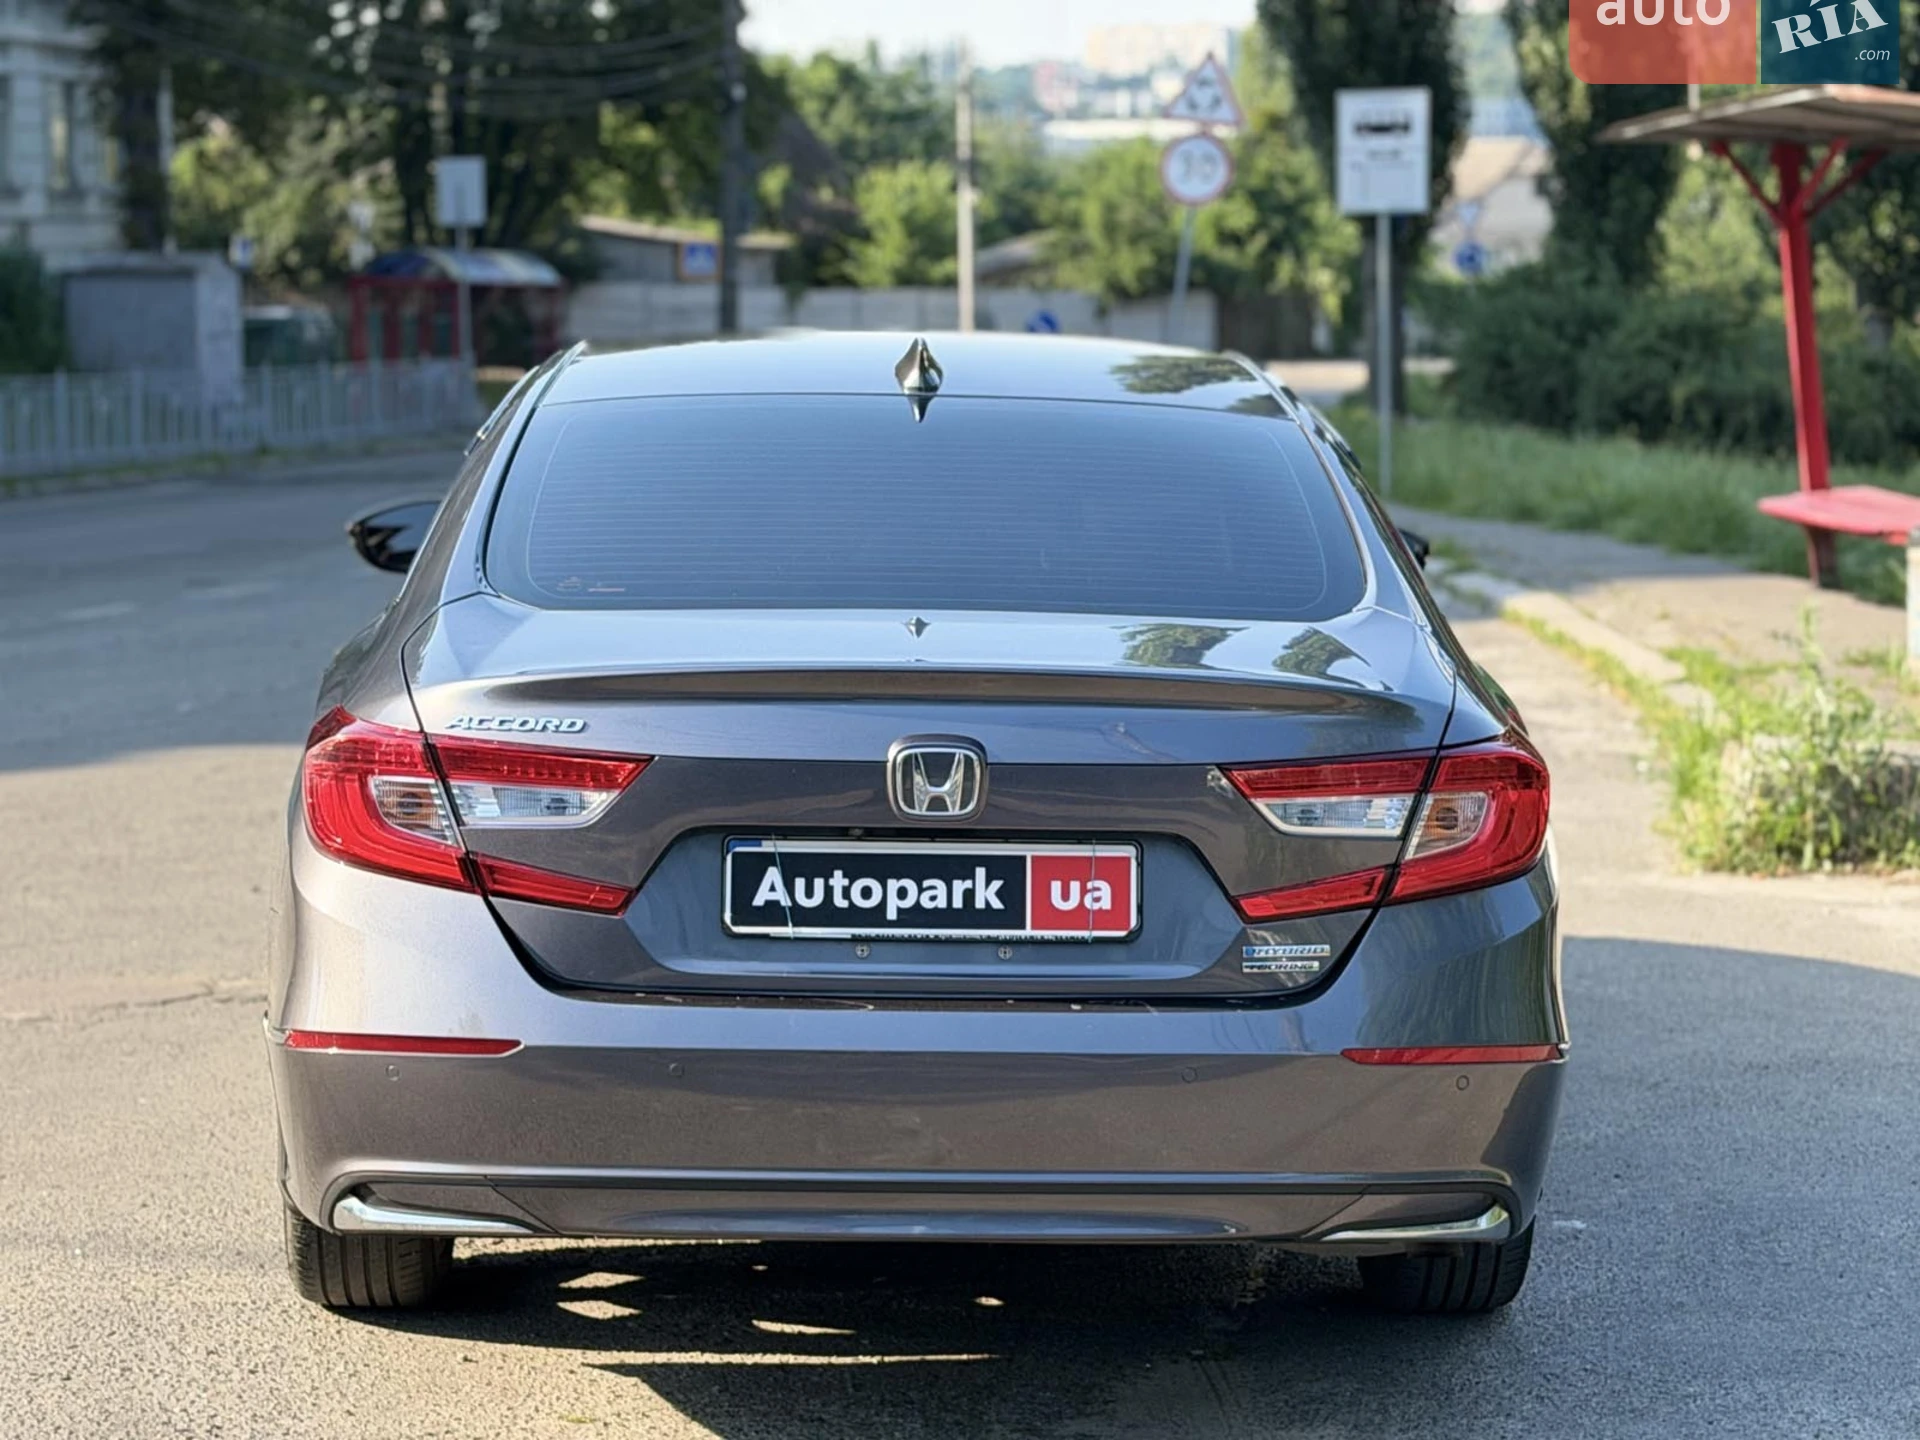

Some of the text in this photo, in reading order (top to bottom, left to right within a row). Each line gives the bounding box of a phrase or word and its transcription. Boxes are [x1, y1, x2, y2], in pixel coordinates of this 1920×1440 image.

[445, 714, 588, 734] ACCORD
[751, 866, 1113, 921] Autopark ua
[1255, 946, 1327, 957] HYBRID
